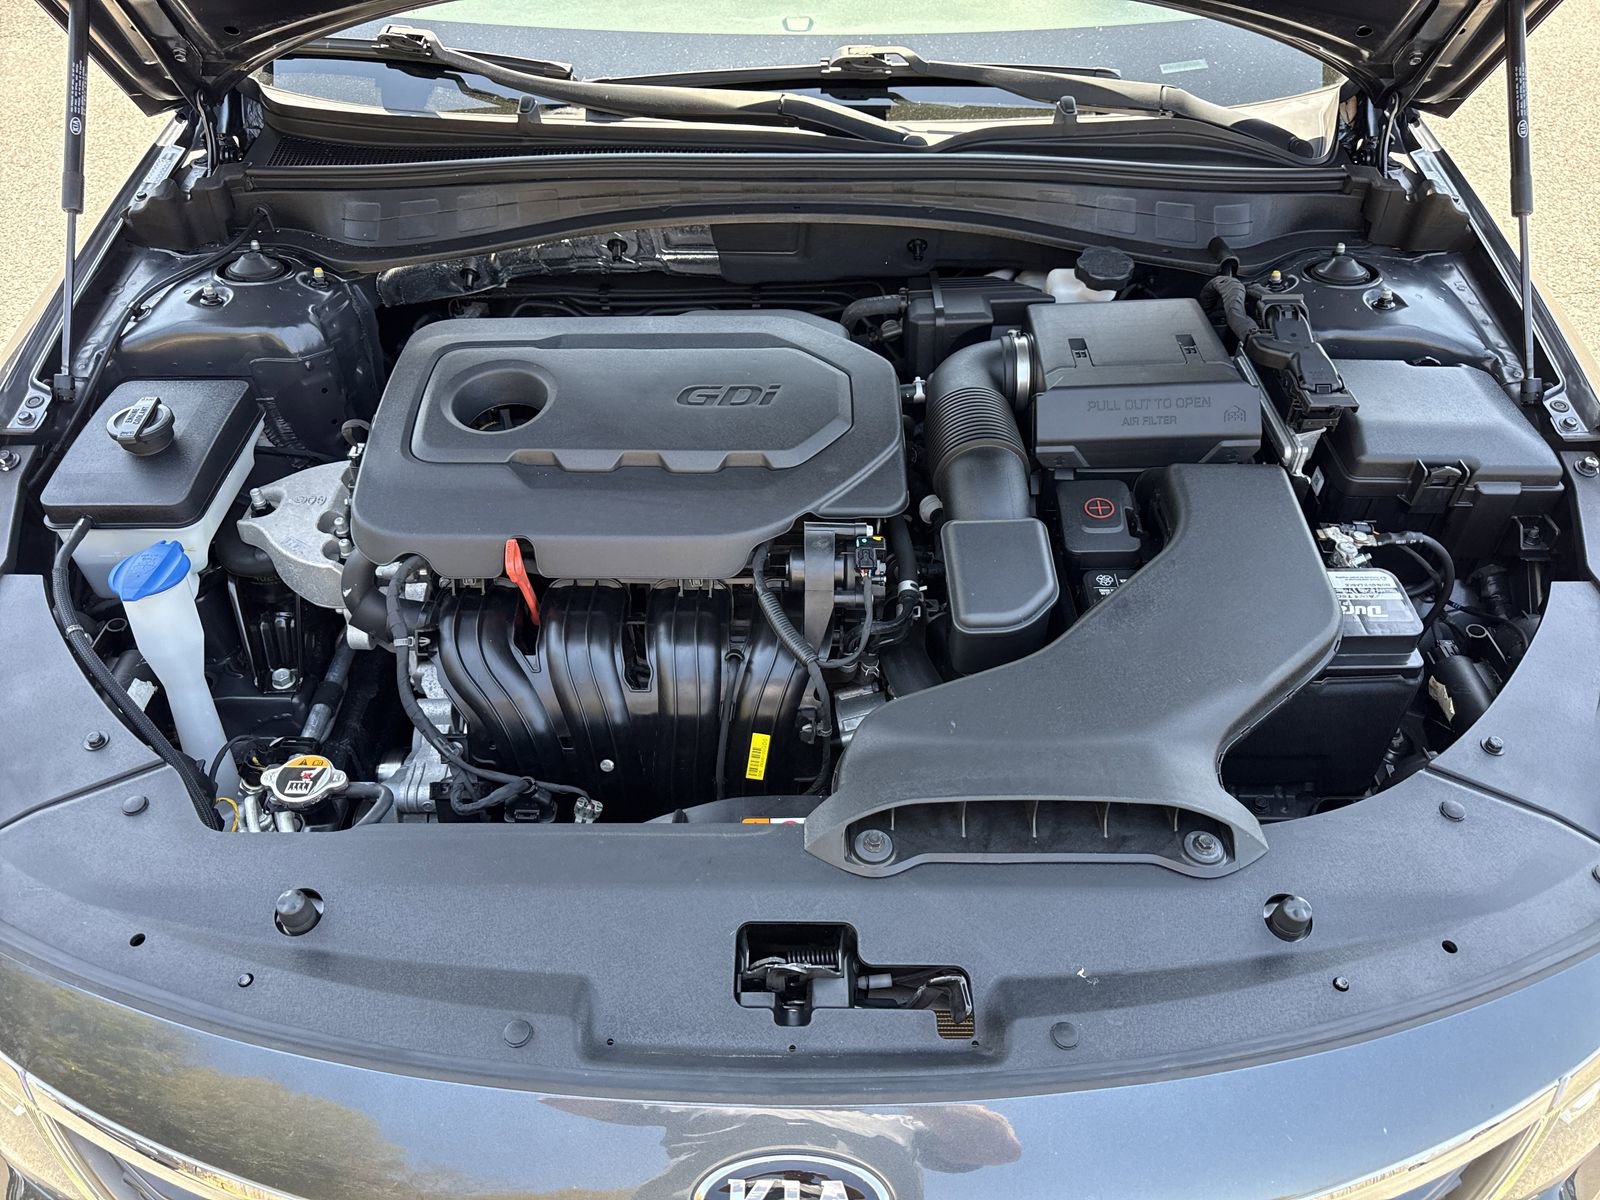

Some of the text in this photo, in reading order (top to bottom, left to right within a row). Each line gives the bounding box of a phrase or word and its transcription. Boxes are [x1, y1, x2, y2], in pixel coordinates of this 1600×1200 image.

[676, 384, 782, 407] GDi
[1087, 396, 1211, 412] PULL OUT TO OPEN
[133, 406, 150, 425] COOLANT
[1121, 415, 1177, 426] AIR FILTER
